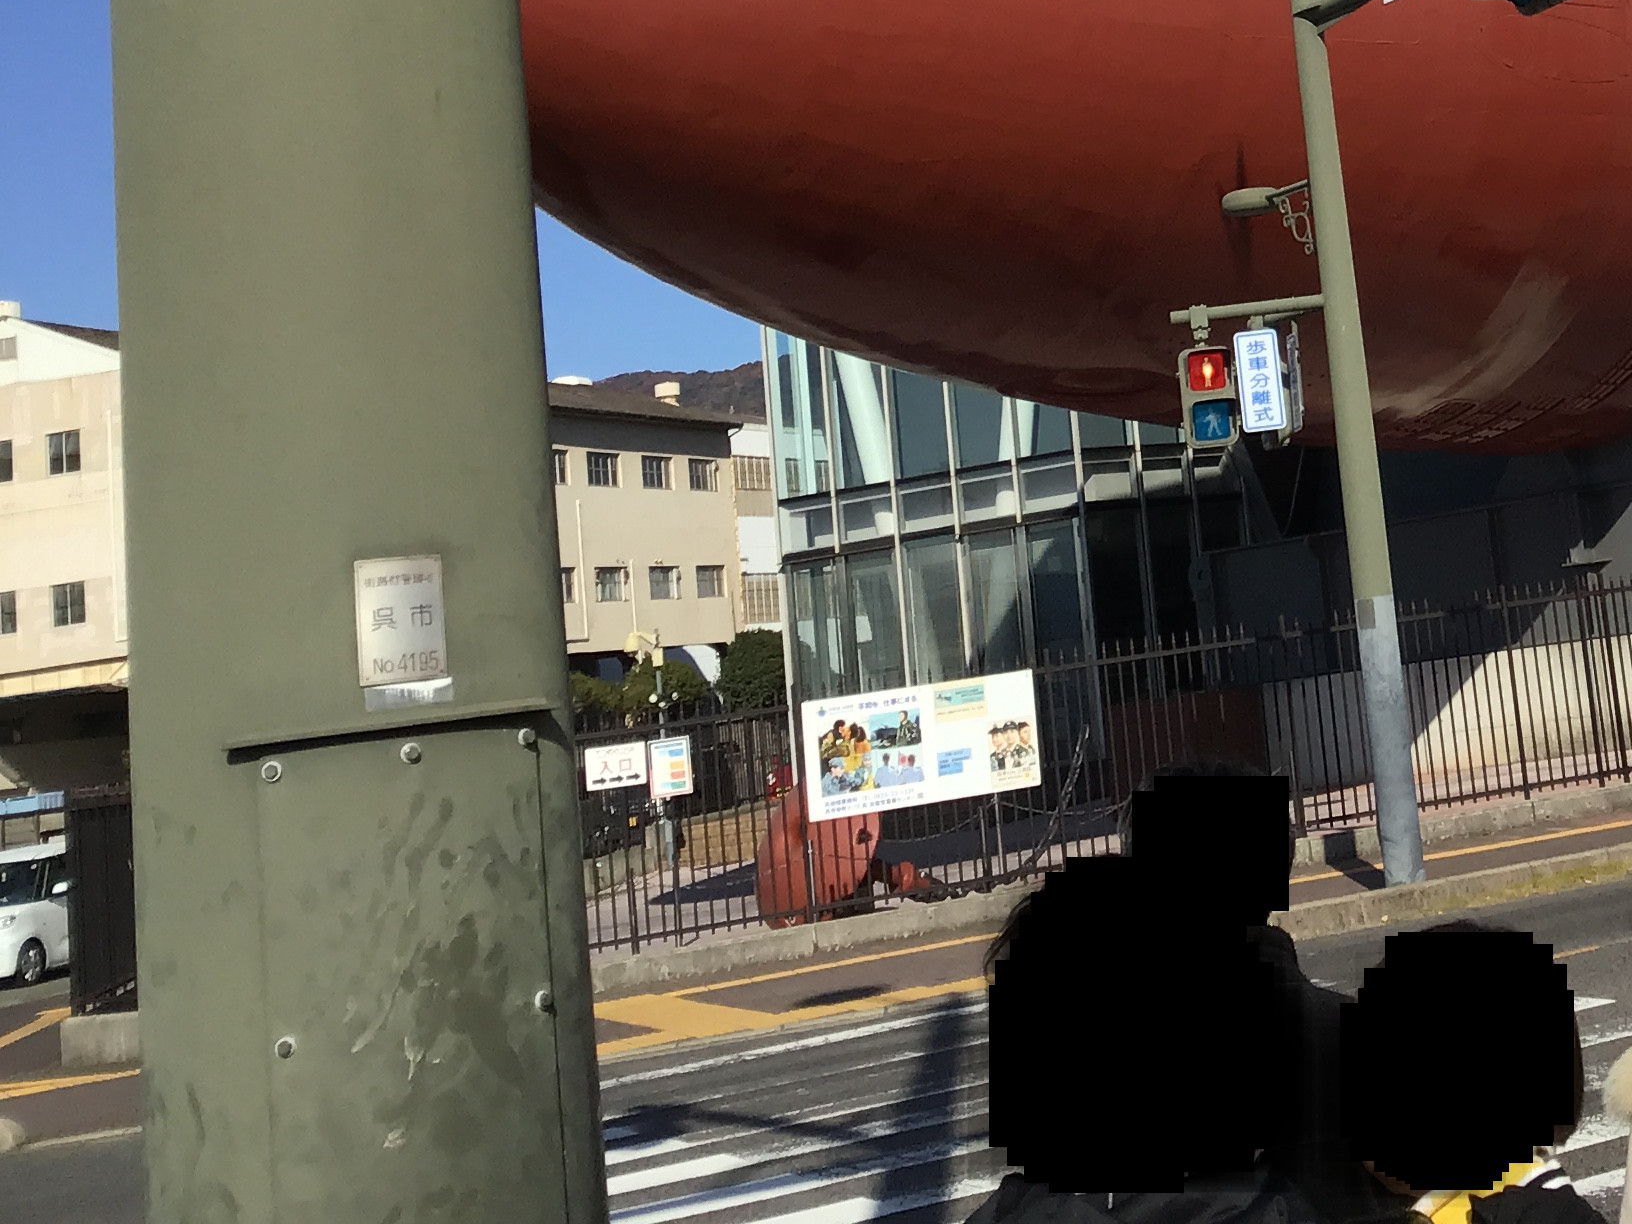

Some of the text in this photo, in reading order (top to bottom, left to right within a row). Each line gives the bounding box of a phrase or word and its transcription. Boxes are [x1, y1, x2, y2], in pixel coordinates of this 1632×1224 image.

[1246, 340, 1275, 423] 歩車分離式
